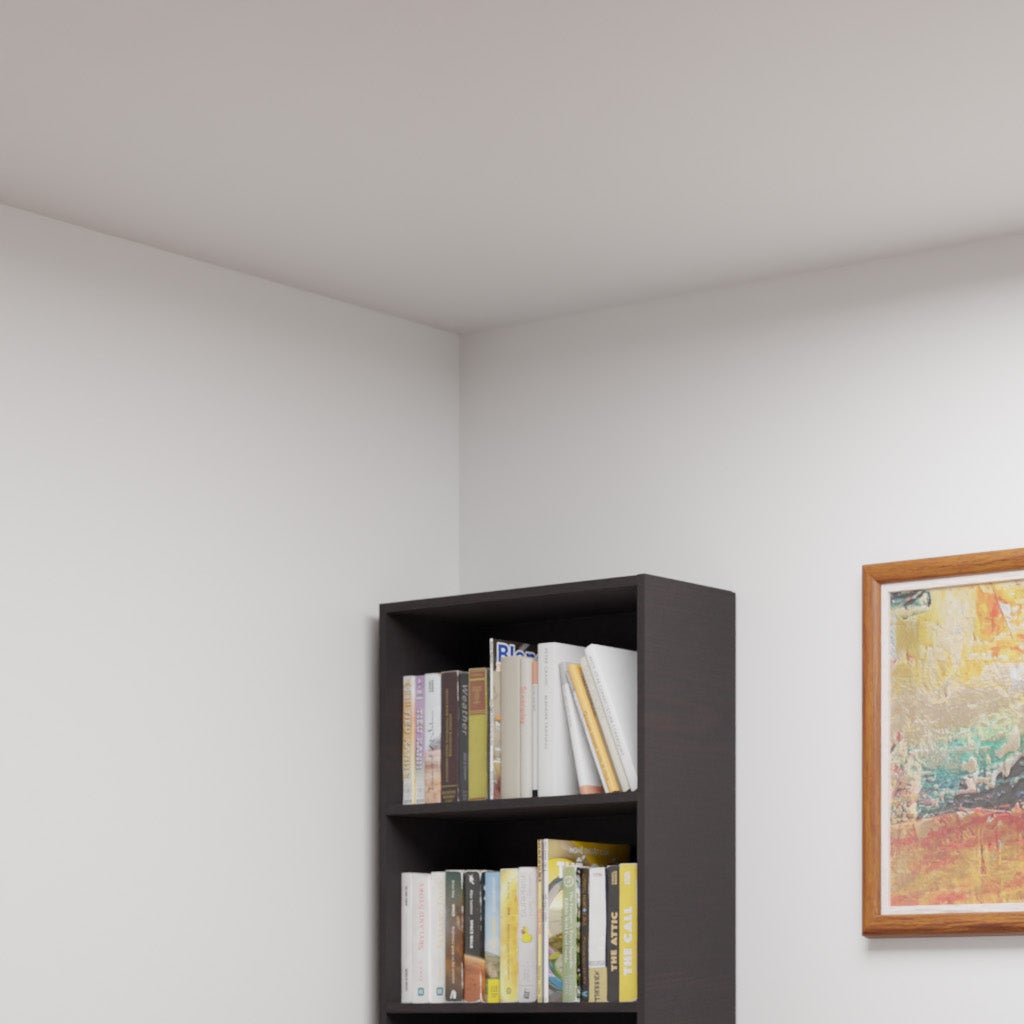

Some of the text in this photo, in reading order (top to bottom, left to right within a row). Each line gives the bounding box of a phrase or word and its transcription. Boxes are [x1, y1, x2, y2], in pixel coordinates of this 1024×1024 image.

[610, 912, 618, 971] THE ATTIC
[623, 907, 633, 975] THE CALL
